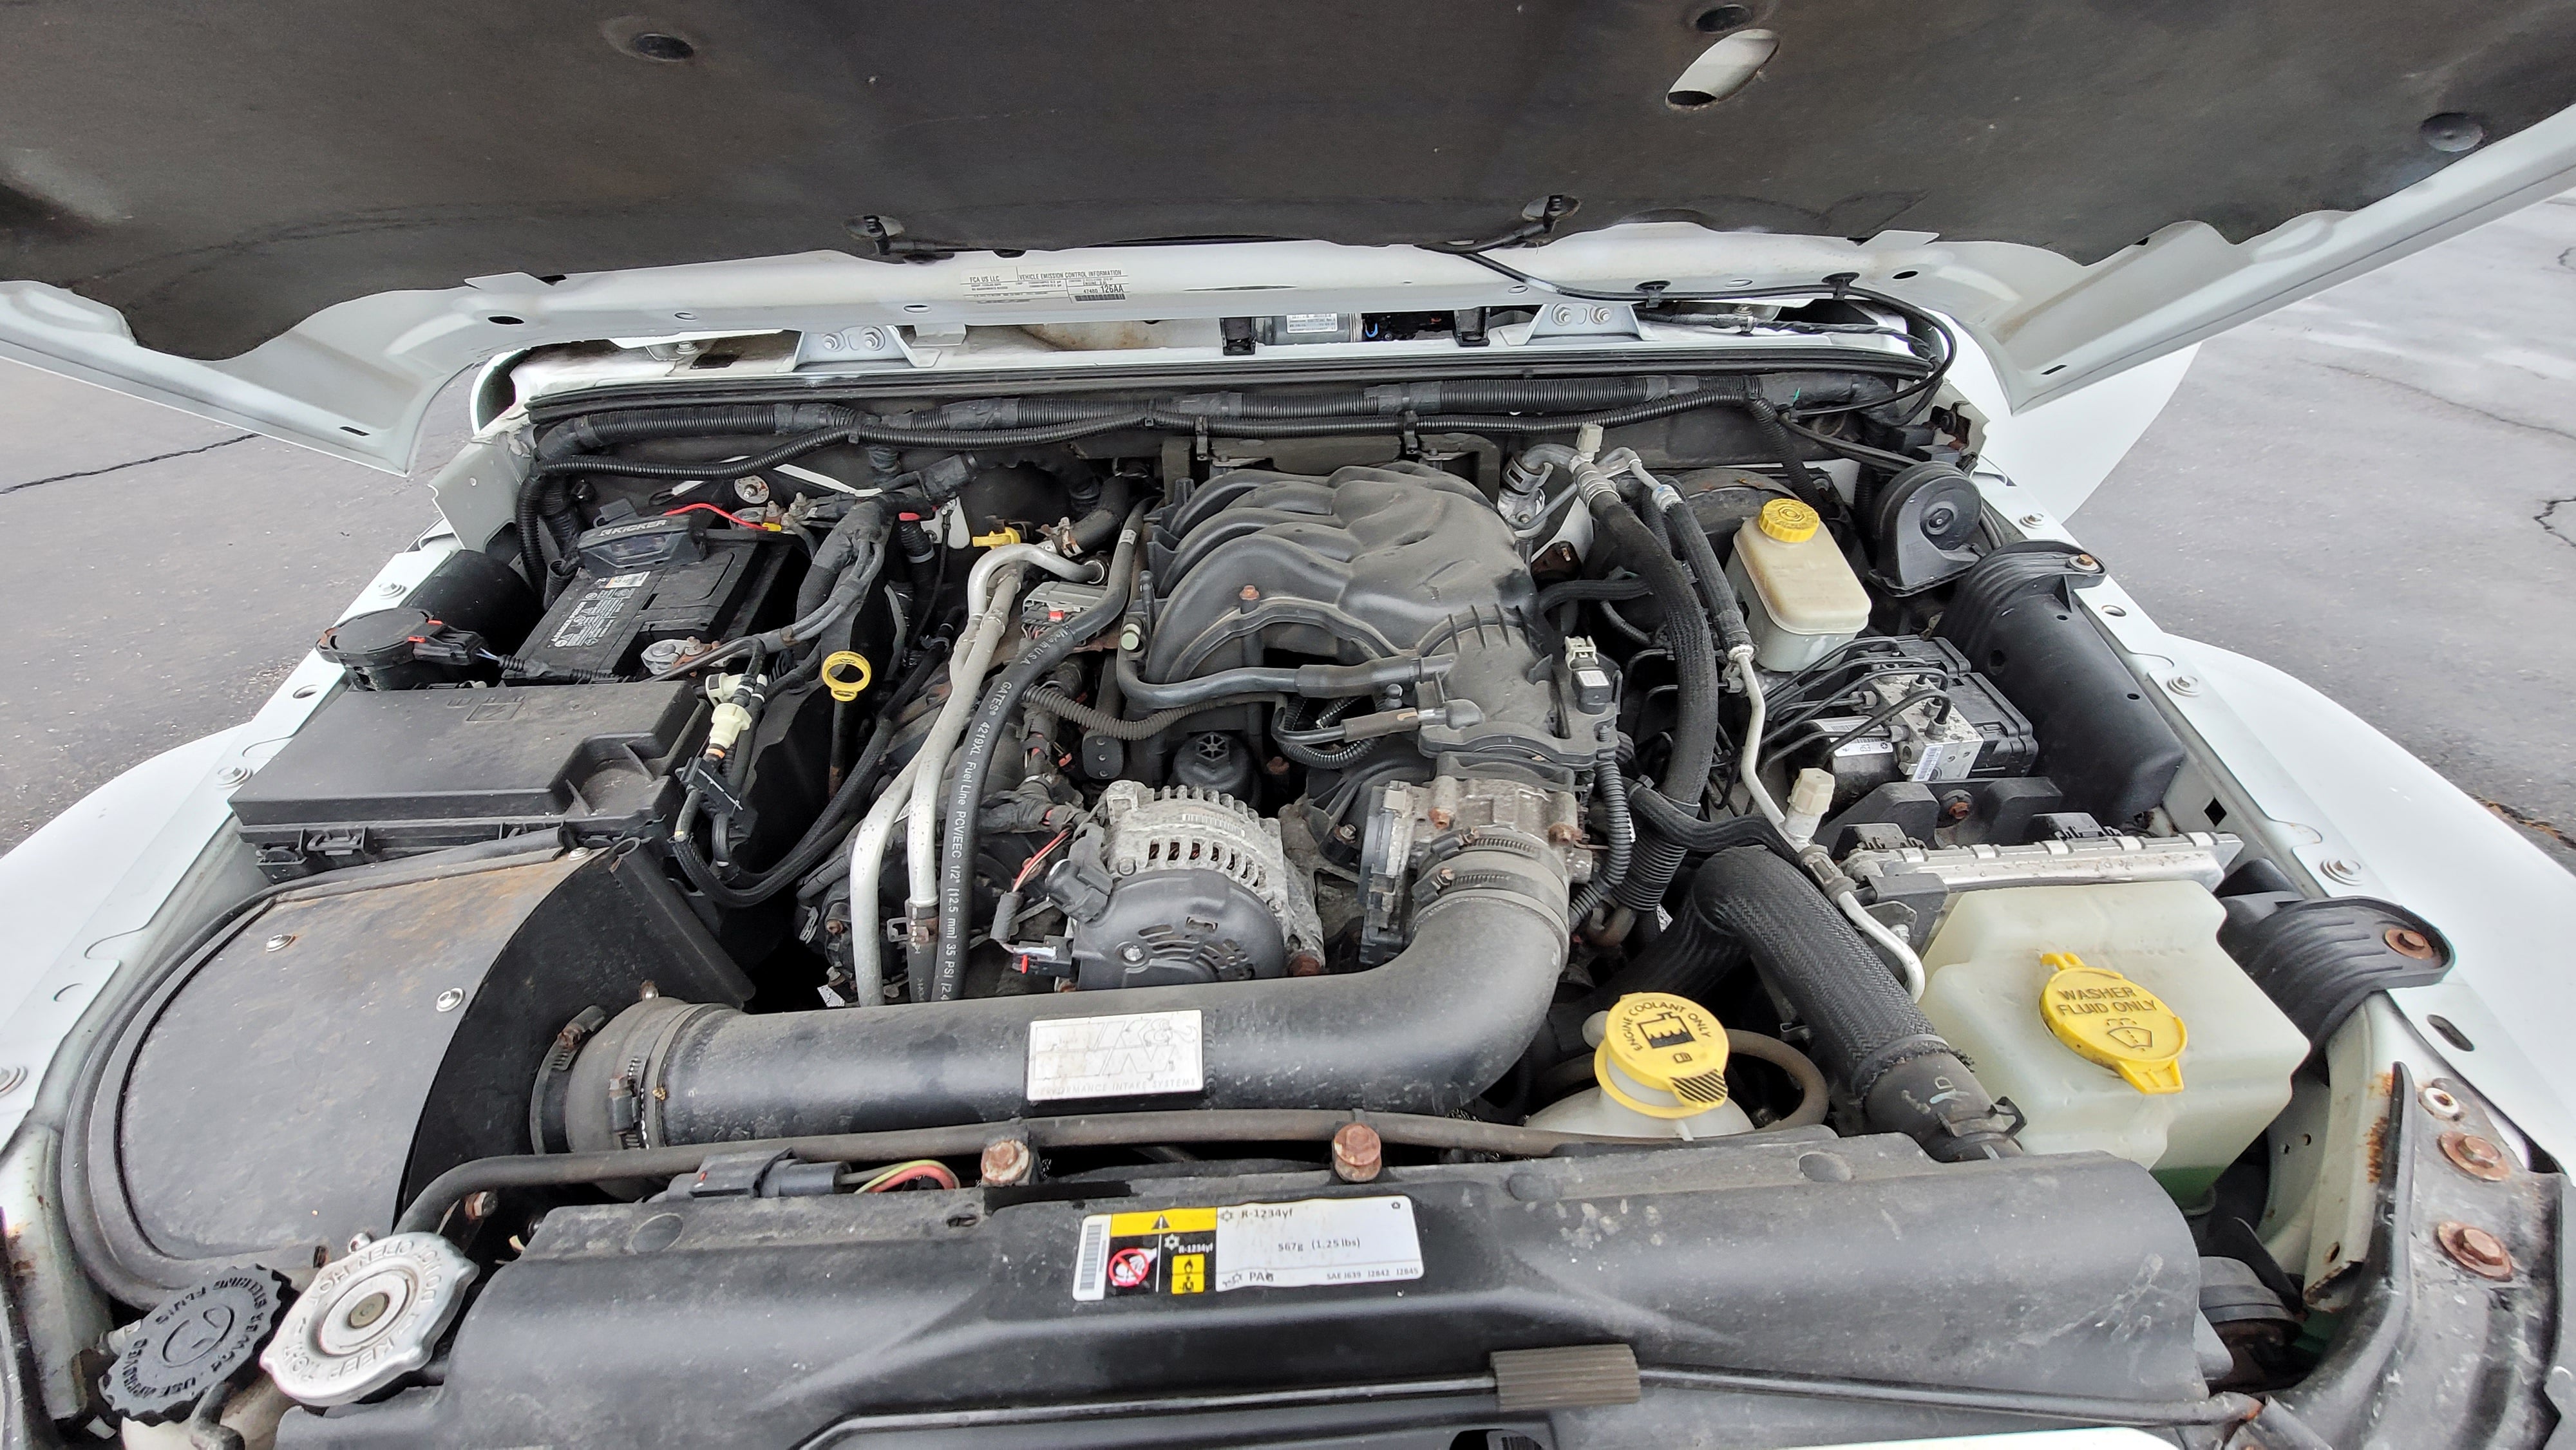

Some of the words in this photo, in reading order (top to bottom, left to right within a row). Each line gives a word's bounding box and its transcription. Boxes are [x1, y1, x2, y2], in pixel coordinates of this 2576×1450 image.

[1101, 285, 1124, 294] 126AA
[612, 520, 667, 535] KICKER
[1020, 647, 1043, 665] USA
[968, 721, 990, 756] 4219XL
[962, 761, 977, 783] Fuel
[958, 784, 972, 805] Line
[952, 811, 967, 858] PCV/EEC
[950, 865, 961, 883] 1/2"
[946, 943, 957, 956] 35
[943, 960, 955, 978] PSI
[2058, 986, 2138, 1001] WASHER
[1629, 1002, 1687, 1016] COOLANT
[2056, 1002, 2109, 1016] FLUID
[2113, 999, 2157, 1012] ONLY
[1622, 1017, 1643, 1051] ENGINE
[1688, 1013, 1712, 1038] ONLY
[1112, 1082, 1147, 1091] INTAKE
[1152, 1078, 1196, 1088] SYSTEMS
[1241, 1209, 1293, 1219] R-1234yf
[357, 1239, 414, 1268] OPEN
[1278, 1243, 1303, 1252] 567g
[1312, 1239, 1340, 1250] (1.25
[1341, 1238, 1360, 1248] lbs)
[309, 1266, 351, 1306] HOT
[156, 1286, 206, 1324] FLUID
[328, 1337, 395, 1380] KEEP
[158, 1377, 196, 1398] USE
